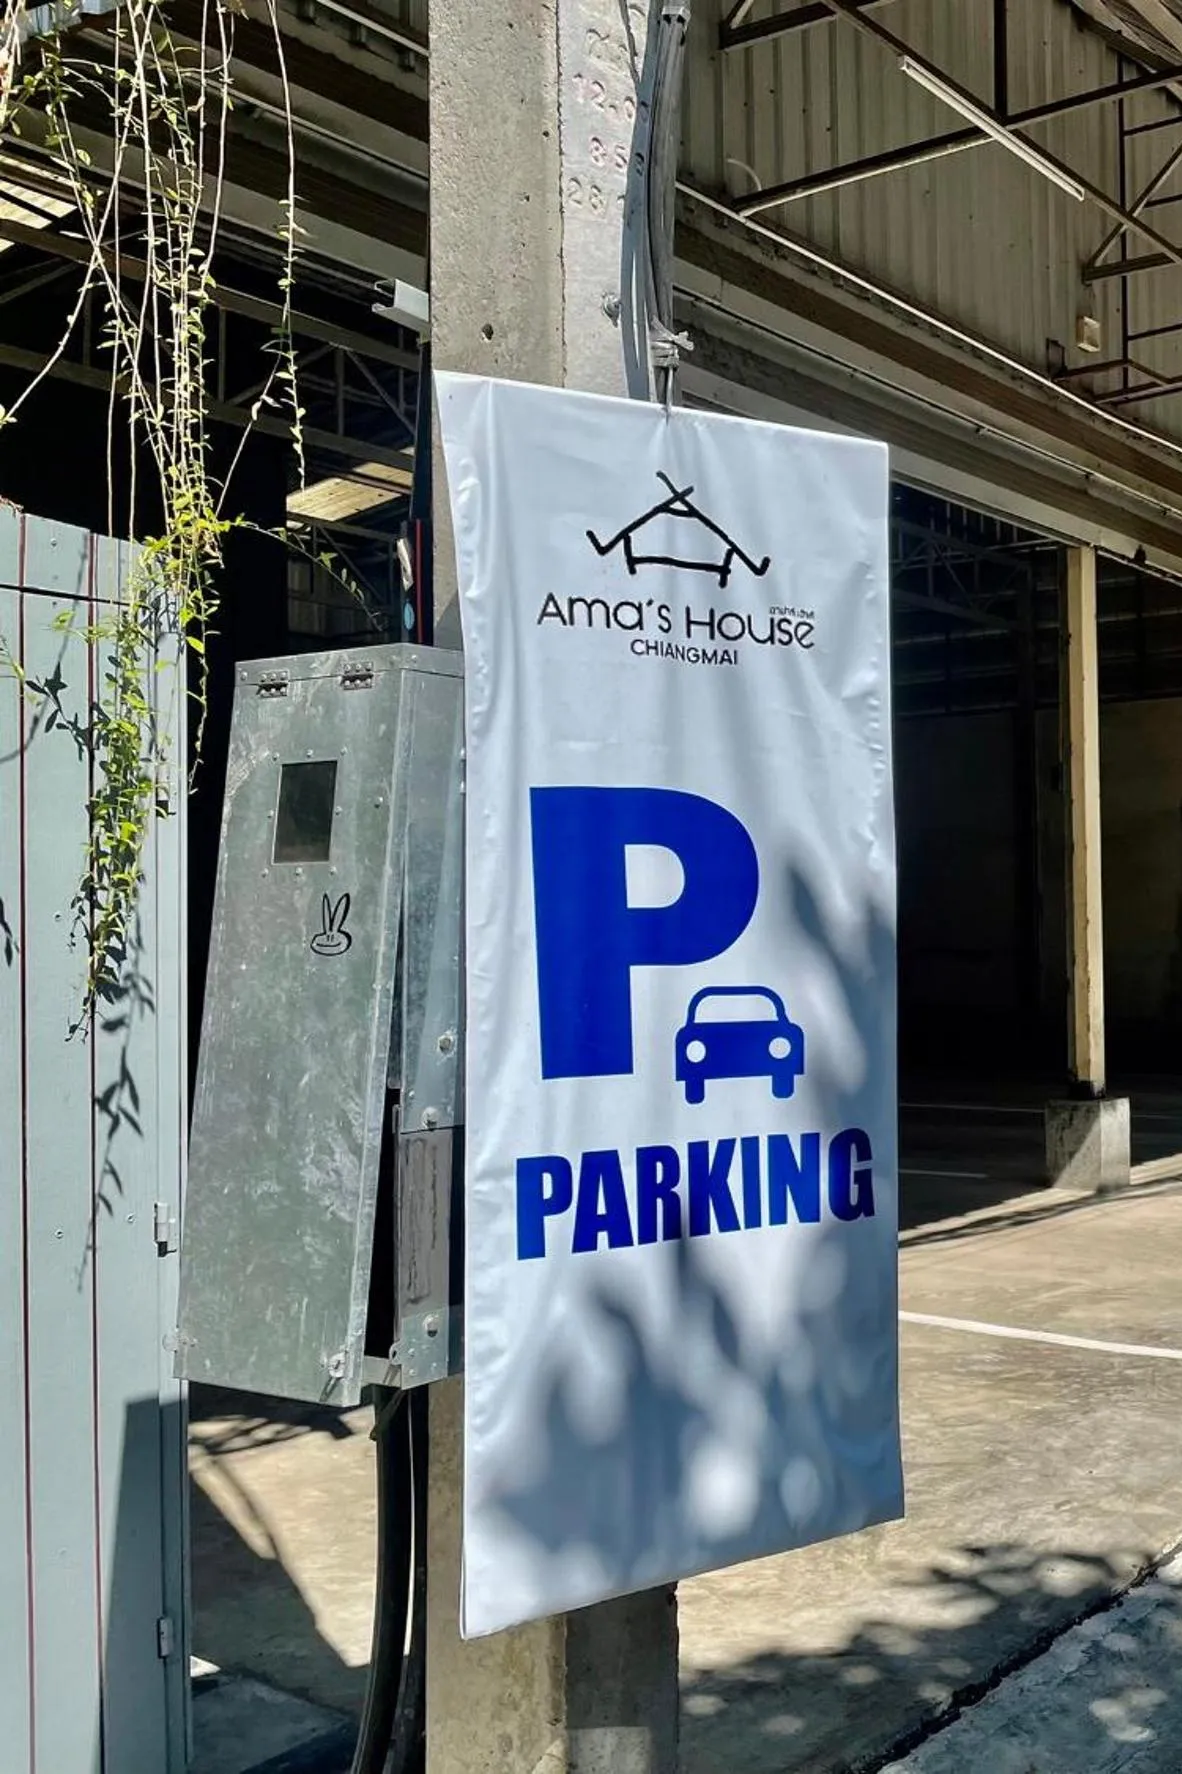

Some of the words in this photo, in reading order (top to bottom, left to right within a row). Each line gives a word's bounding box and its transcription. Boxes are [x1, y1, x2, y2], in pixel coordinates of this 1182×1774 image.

[537, 592, 672, 634] Ama's
[685, 605, 816, 649] House
[630, 638, 739, 666] CHIANGMAI
[529, 786, 760, 1081] P
[515, 1127, 876, 1261] PARKING
